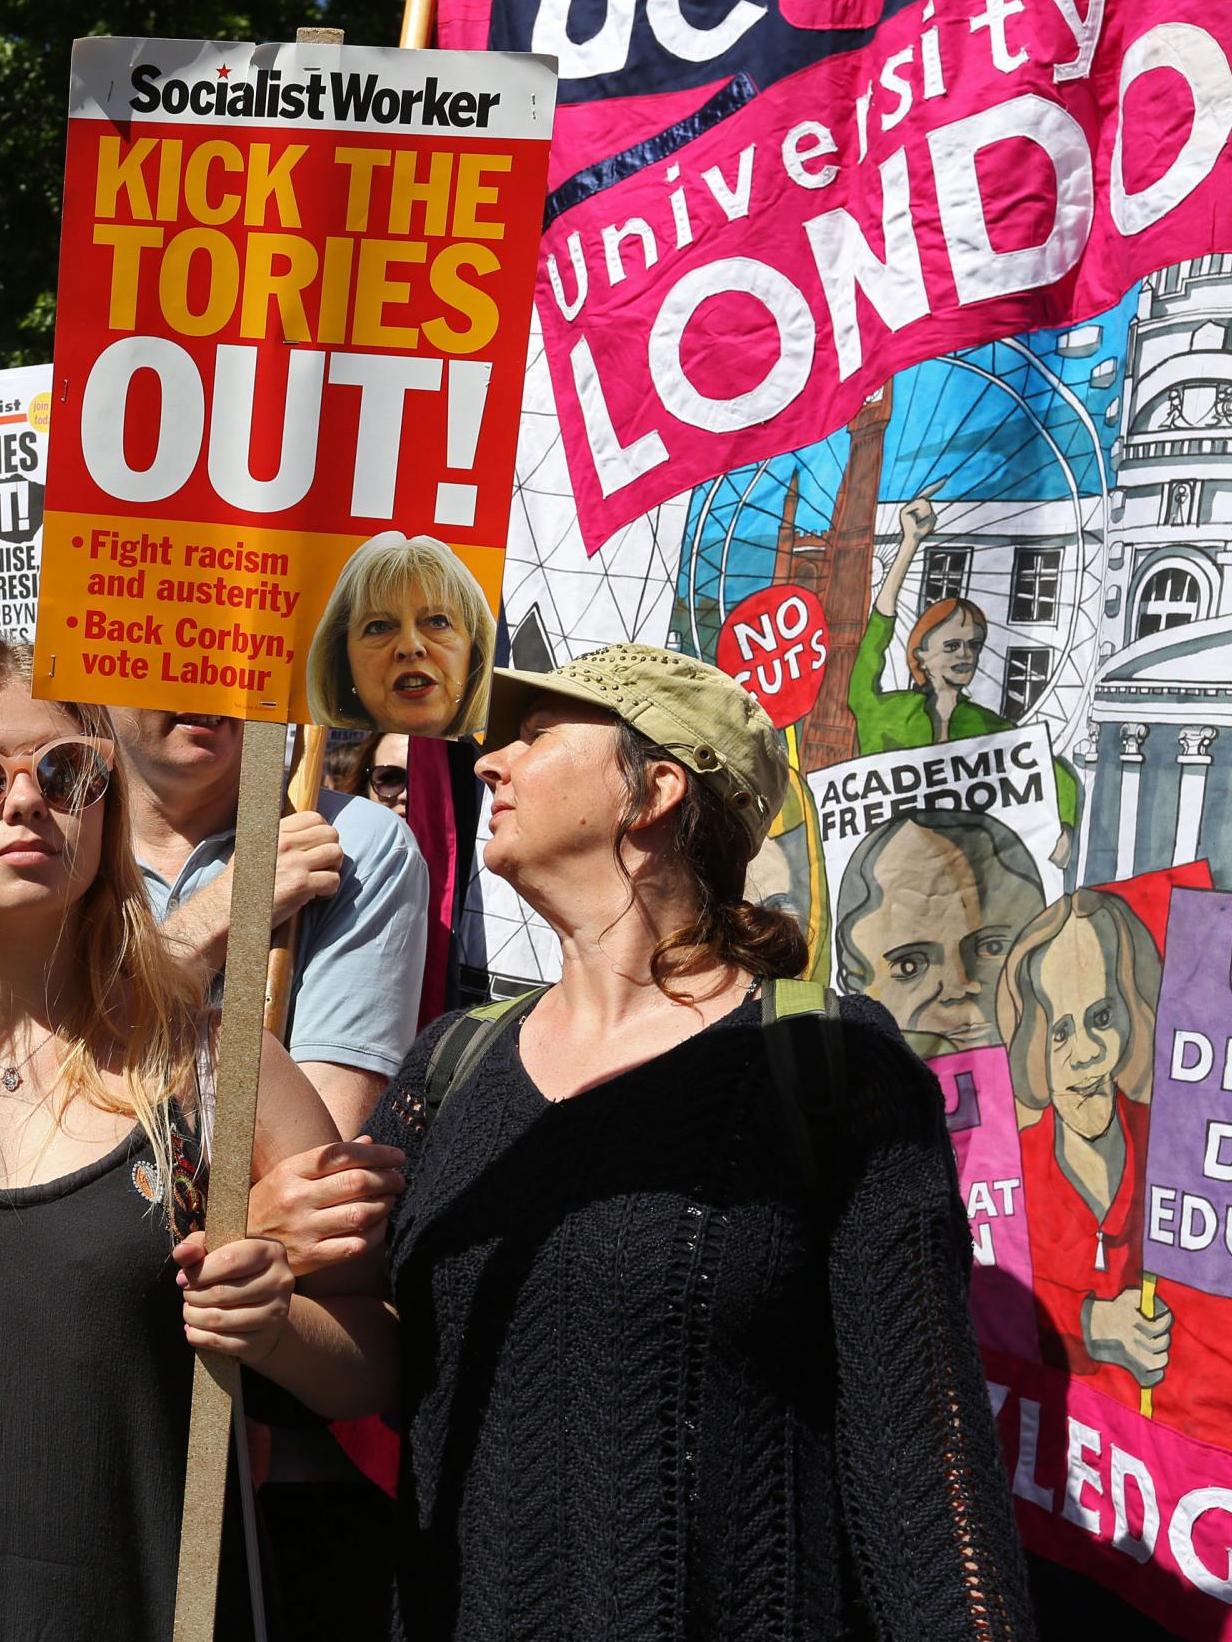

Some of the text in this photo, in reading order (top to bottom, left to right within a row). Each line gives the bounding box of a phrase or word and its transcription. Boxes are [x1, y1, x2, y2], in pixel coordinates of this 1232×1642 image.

[93, 135, 513, 240] KICK THE
[547, 0, 1105, 322] University
[92, 224, 502, 354] TORIES
[80, 335, 493, 527] OUT!
[90, 529, 289, 576] Fight racism
[87, 570, 301, 618] and austerity
[83, 610, 296, 664] Back Corbyn,
[733, 596, 808, 660] NO
[82, 650, 272, 692] vote Labour
[820, 741, 1038, 808] ACADEMIC
